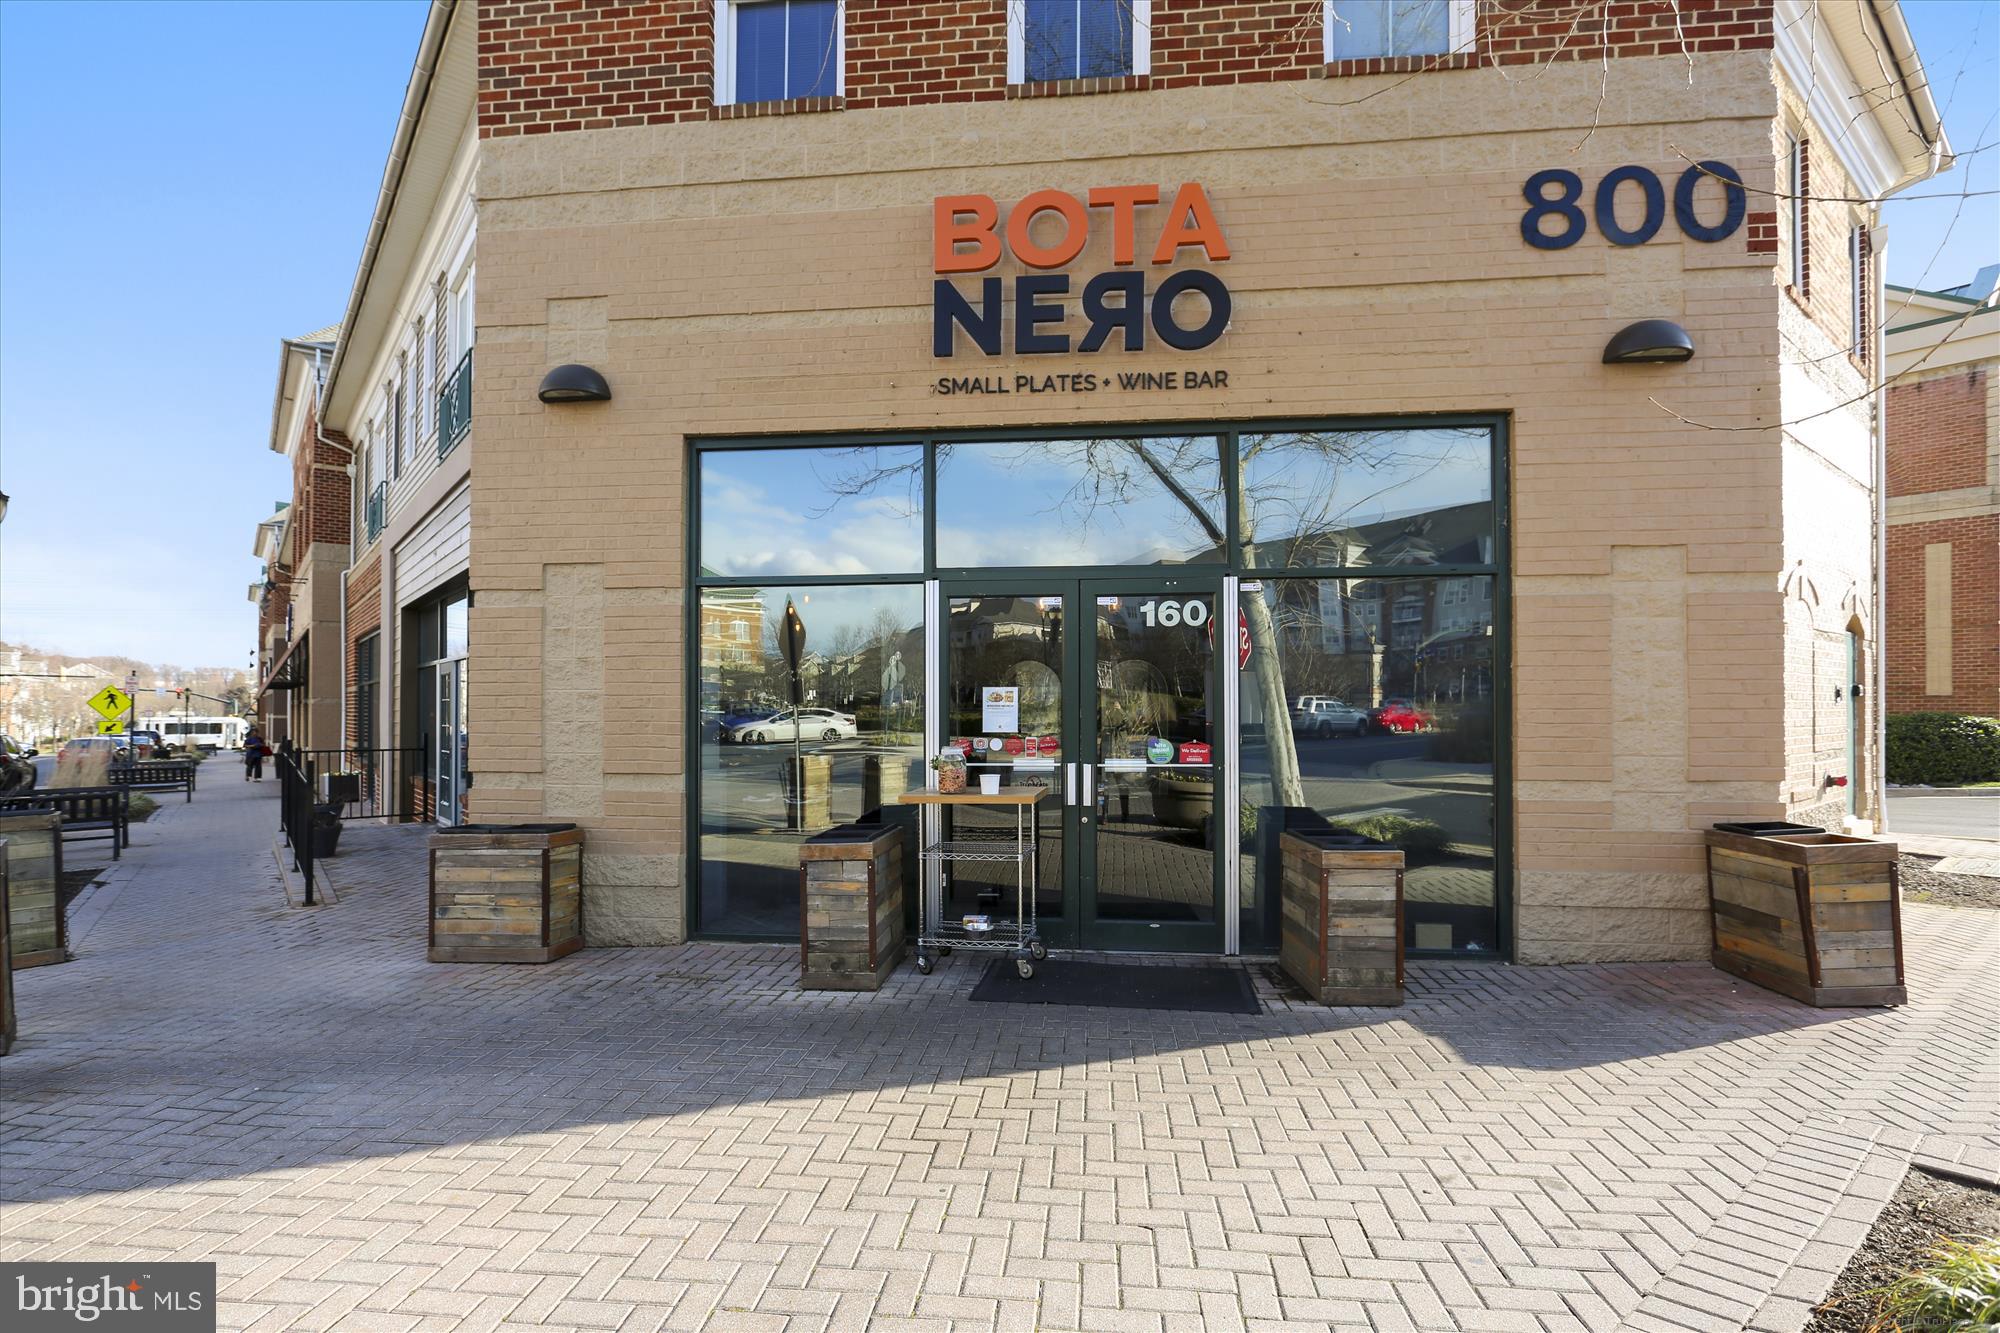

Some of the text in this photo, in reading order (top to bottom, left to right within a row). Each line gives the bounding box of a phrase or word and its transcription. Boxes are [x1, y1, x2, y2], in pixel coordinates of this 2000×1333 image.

[933, 182, 1231, 274] BOTA
[1520, 160, 1747, 250] 800
[938, 376, 1010, 395] SMALL
[1016, 373, 1097, 393] PLATES
[1117, 372, 1177, 391] WINE
[1184, 370, 1229, 389] BAR
[1140, 600, 1208, 628] 160
